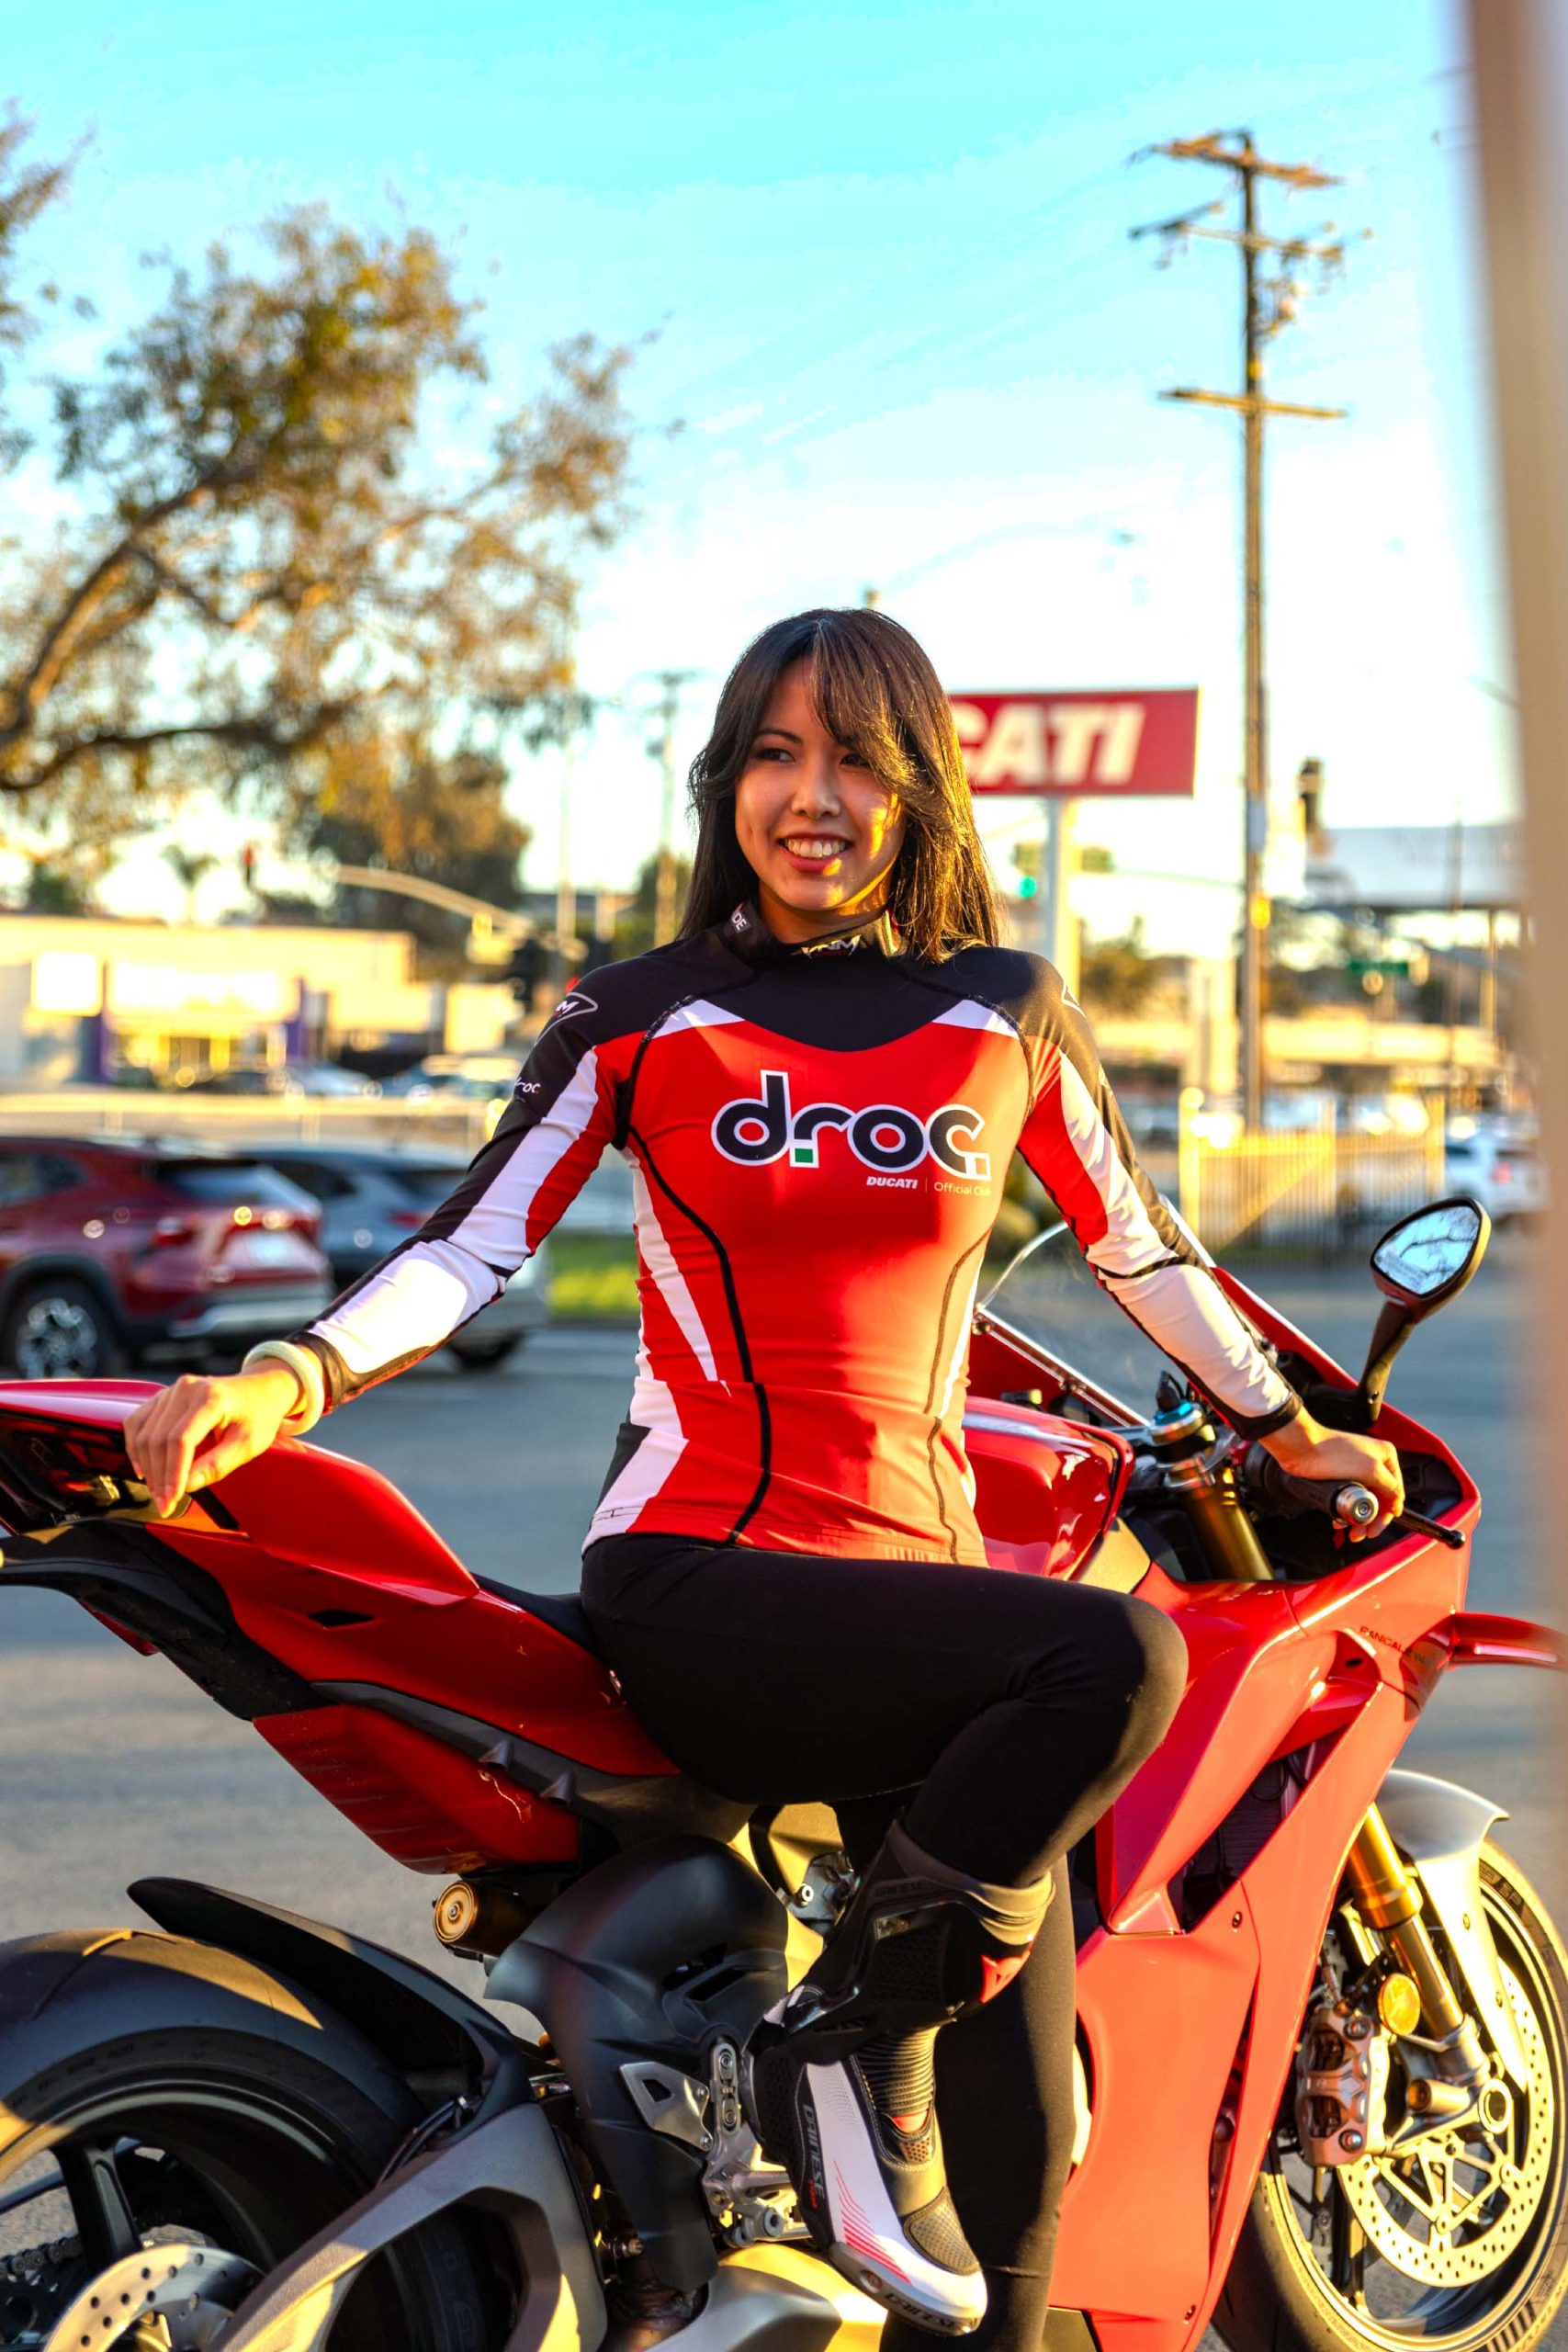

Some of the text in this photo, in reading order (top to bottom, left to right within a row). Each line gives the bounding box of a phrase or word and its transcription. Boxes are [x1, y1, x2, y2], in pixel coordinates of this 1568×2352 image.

[711, 1069, 991, 1182] droc
[866, 1175, 919, 1190] DUCATI
[933, 1181, 972, 1195] Official
[803, 2103, 826, 2200] DAINESE
